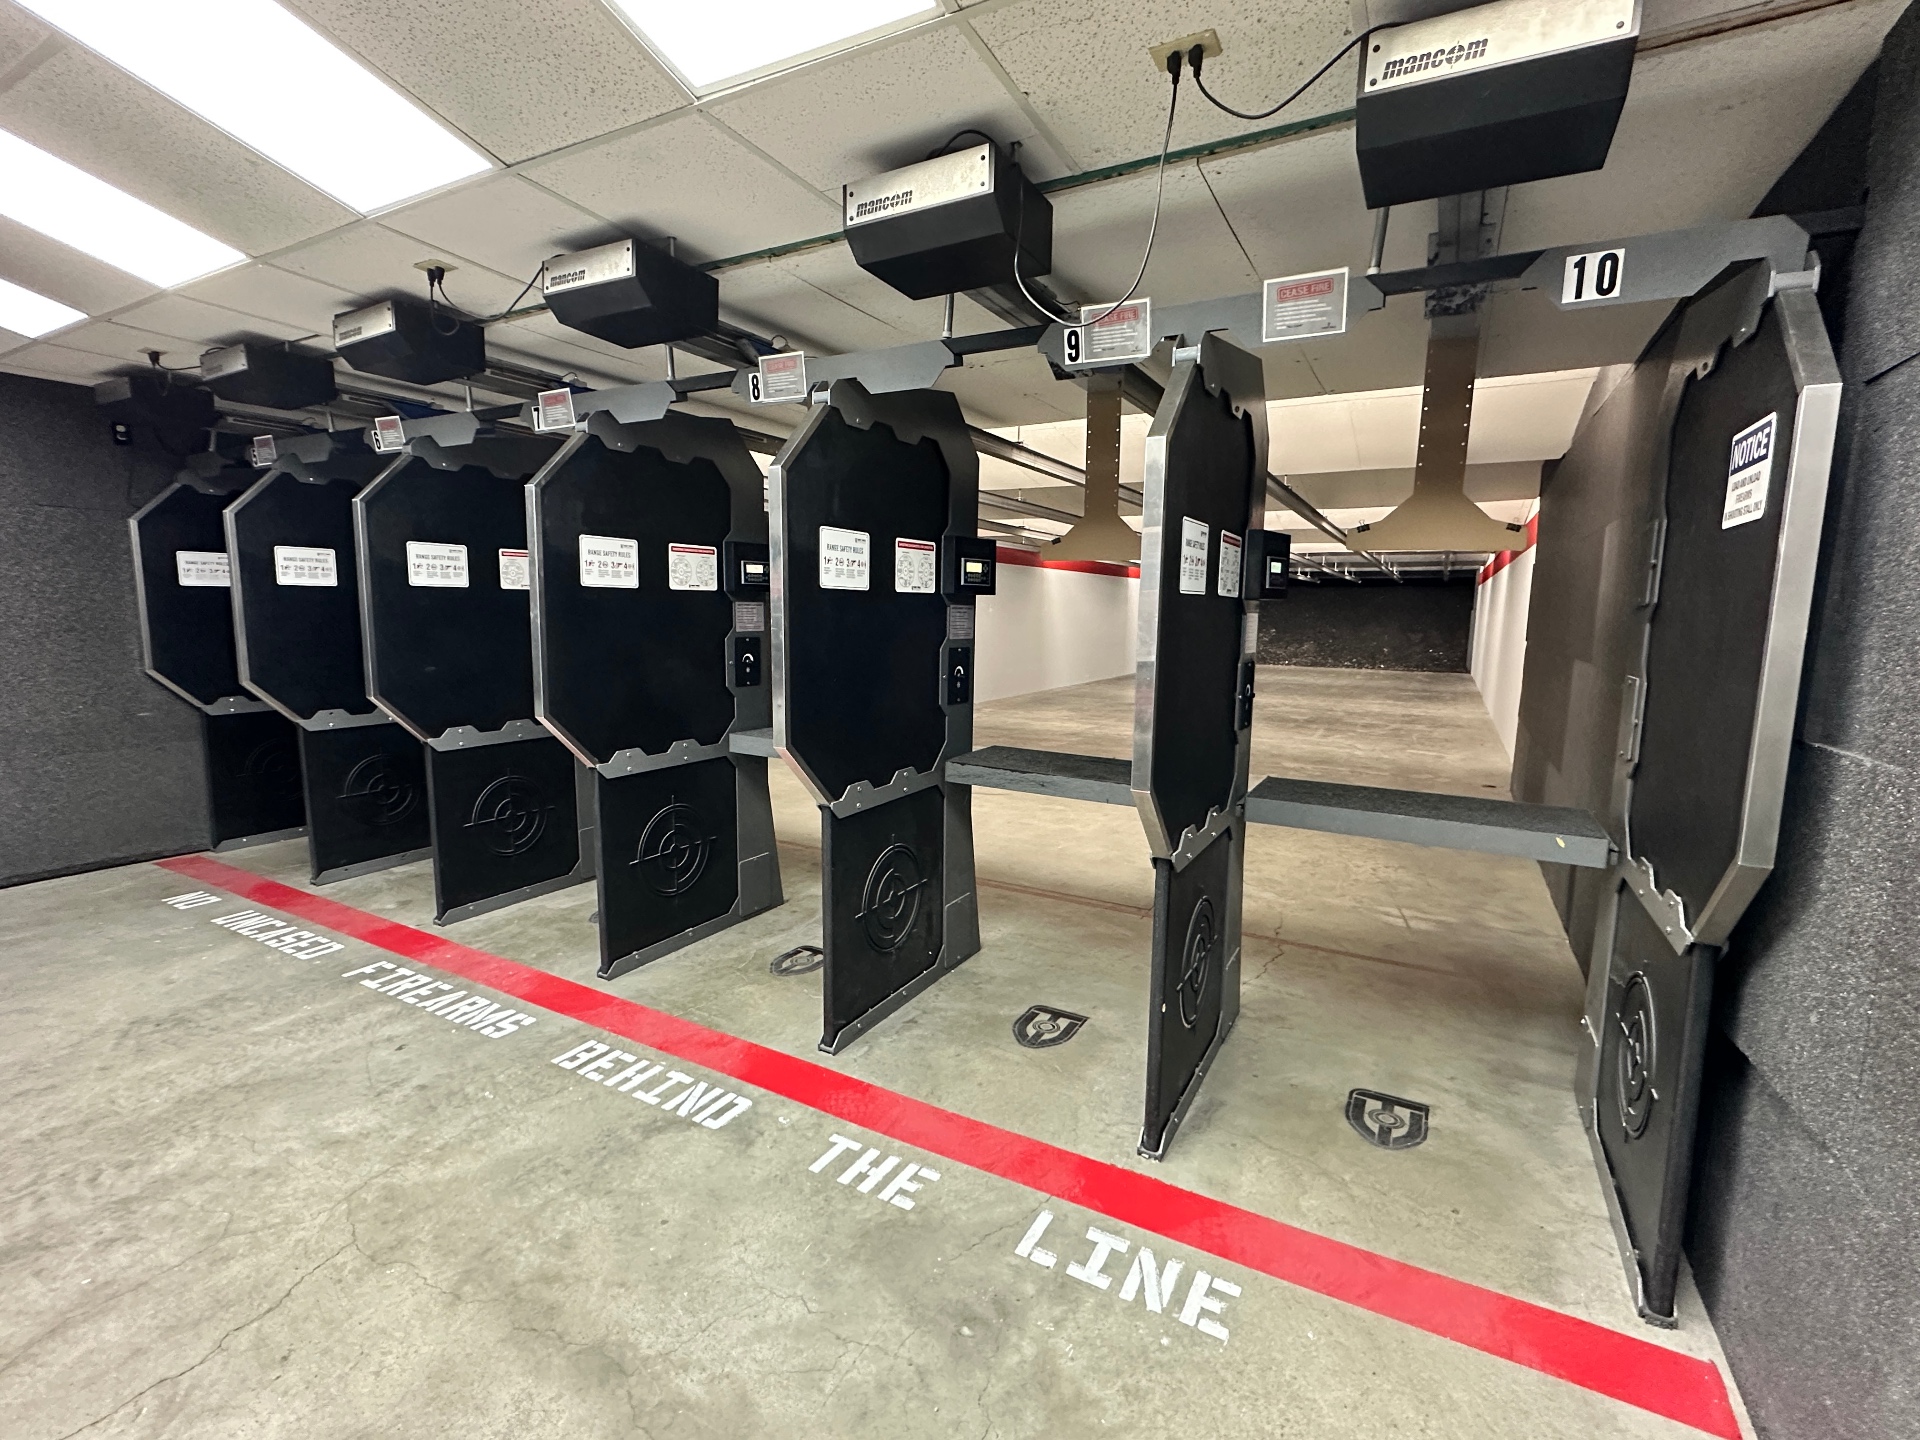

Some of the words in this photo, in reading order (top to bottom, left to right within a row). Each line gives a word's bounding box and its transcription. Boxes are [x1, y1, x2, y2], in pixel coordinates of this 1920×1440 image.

[1382, 38, 1488, 81] mancom
[856, 189, 913, 217] mancom
[1281, 286, 1309, 299] CEASE
[1311, 282, 1330, 293] FIRE
[1574, 252, 1619, 299] 10
[1067, 329, 1080, 363] 9
[752, 375, 760, 401] 8
[533, 407, 540, 430] 7
[374, 431, 382, 450] 6
[1731, 426, 1771, 471] NOTICE
[161, 890, 222, 910] NO
[210, 909, 345, 961] UNCASED
[341, 960, 537, 1039] FIREARMS
[550, 1039, 753, 1130] BEHIND
[808, 1133, 942, 1211] THE
[1014, 1209, 1242, 1341] LINE
